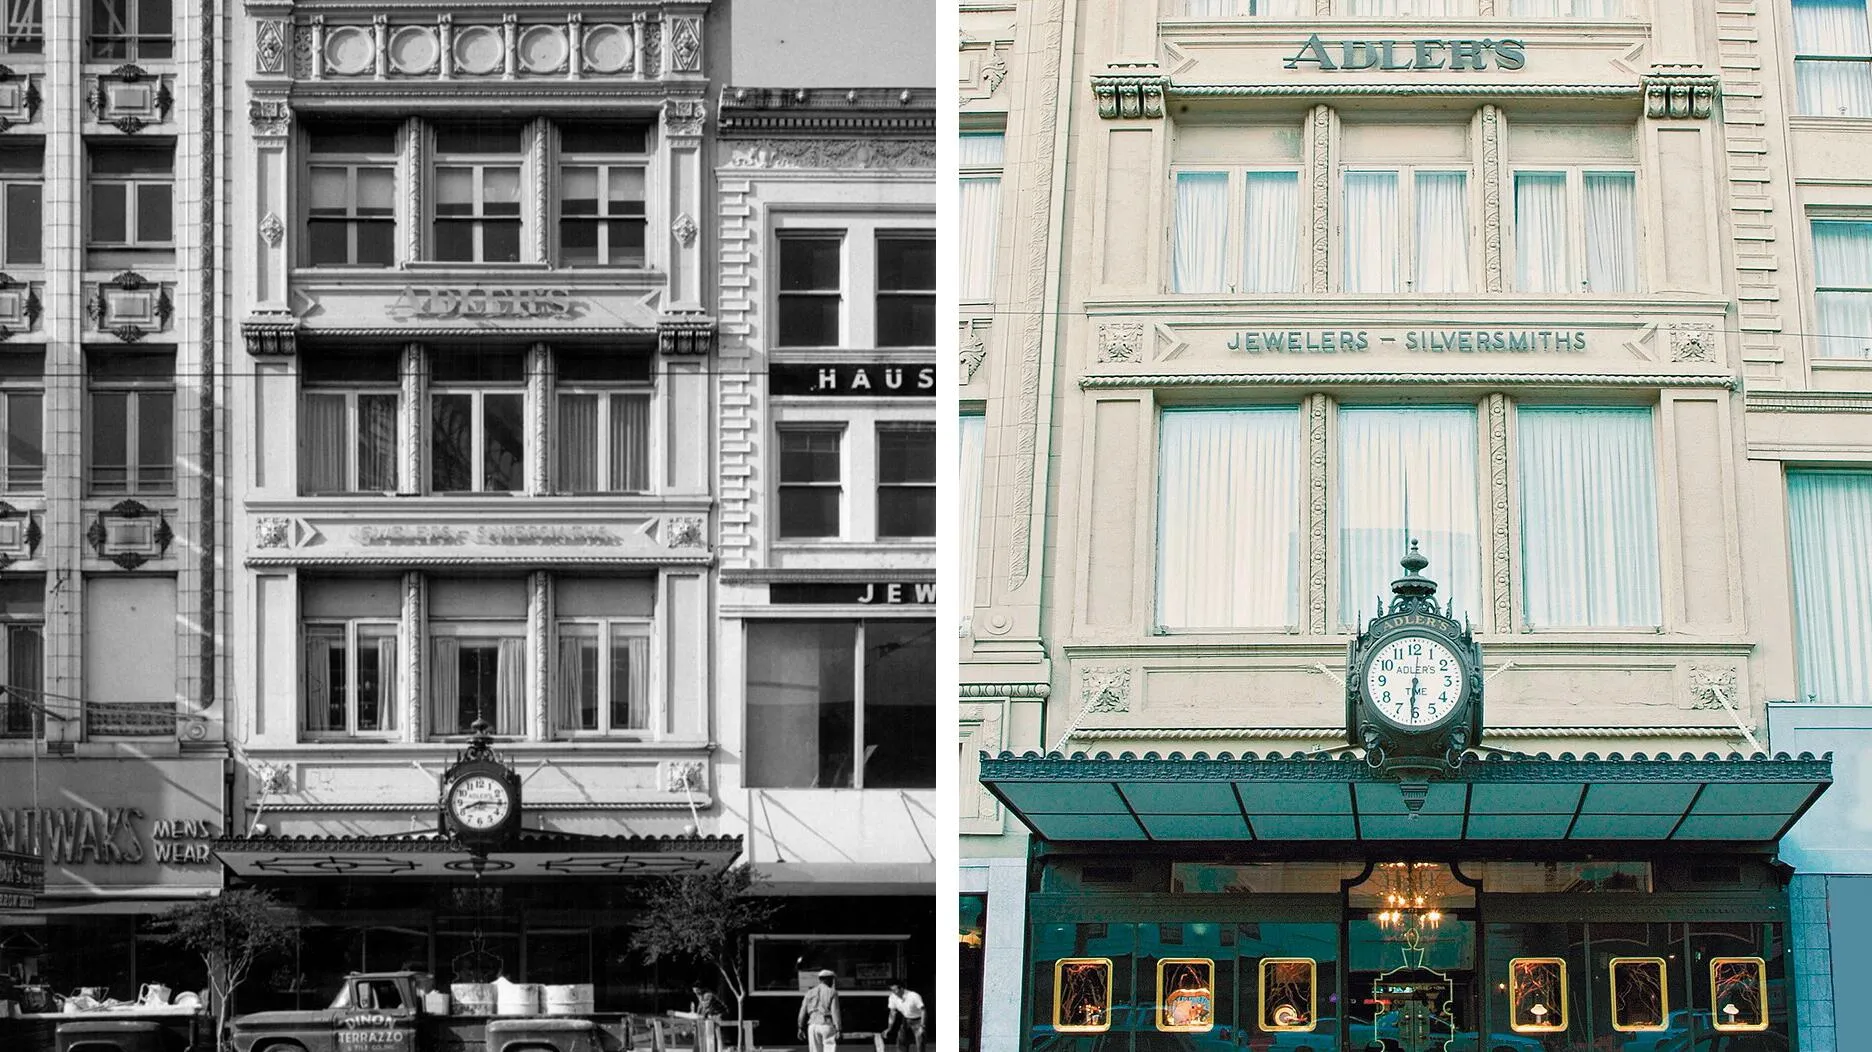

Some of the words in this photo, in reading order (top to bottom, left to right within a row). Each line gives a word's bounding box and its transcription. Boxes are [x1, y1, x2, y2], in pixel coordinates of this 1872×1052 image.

[1283, 33, 1525, 71] ADLER'S
[1227, 331, 1369, 352] JEWELERS
[1405, 330, 1587, 352] SILVERSMITHS
[858, 584, 936, 604] JEW
[1382, 615, 1450, 632] ADLER'S
[1394, 648, 1403, 660] 11
[1408, 644, 1422, 656] 12
[1429, 648, 1433, 660] 1
[1381, 659, 1393, 671] 10
[1396, 665, 1436, 675] ADLER'S
[1440, 659, 1449, 671] 2
[1378, 676, 1387, 687] 9
[1444, 676, 1452, 687] 3
[1382, 691, 1391, 703] 8
[1405, 687, 1428, 696] TME
[1439, 691, 1447, 703] 4
[1395, 703, 1404, 714] 7
[1412, 706, 1420, 719] 6
[1428, 703, 1436, 715] 5
[153, 819, 209, 838] MENS
[154, 842, 210, 863] WEAR
[338, 1031, 403, 1043] TERRAZZO
